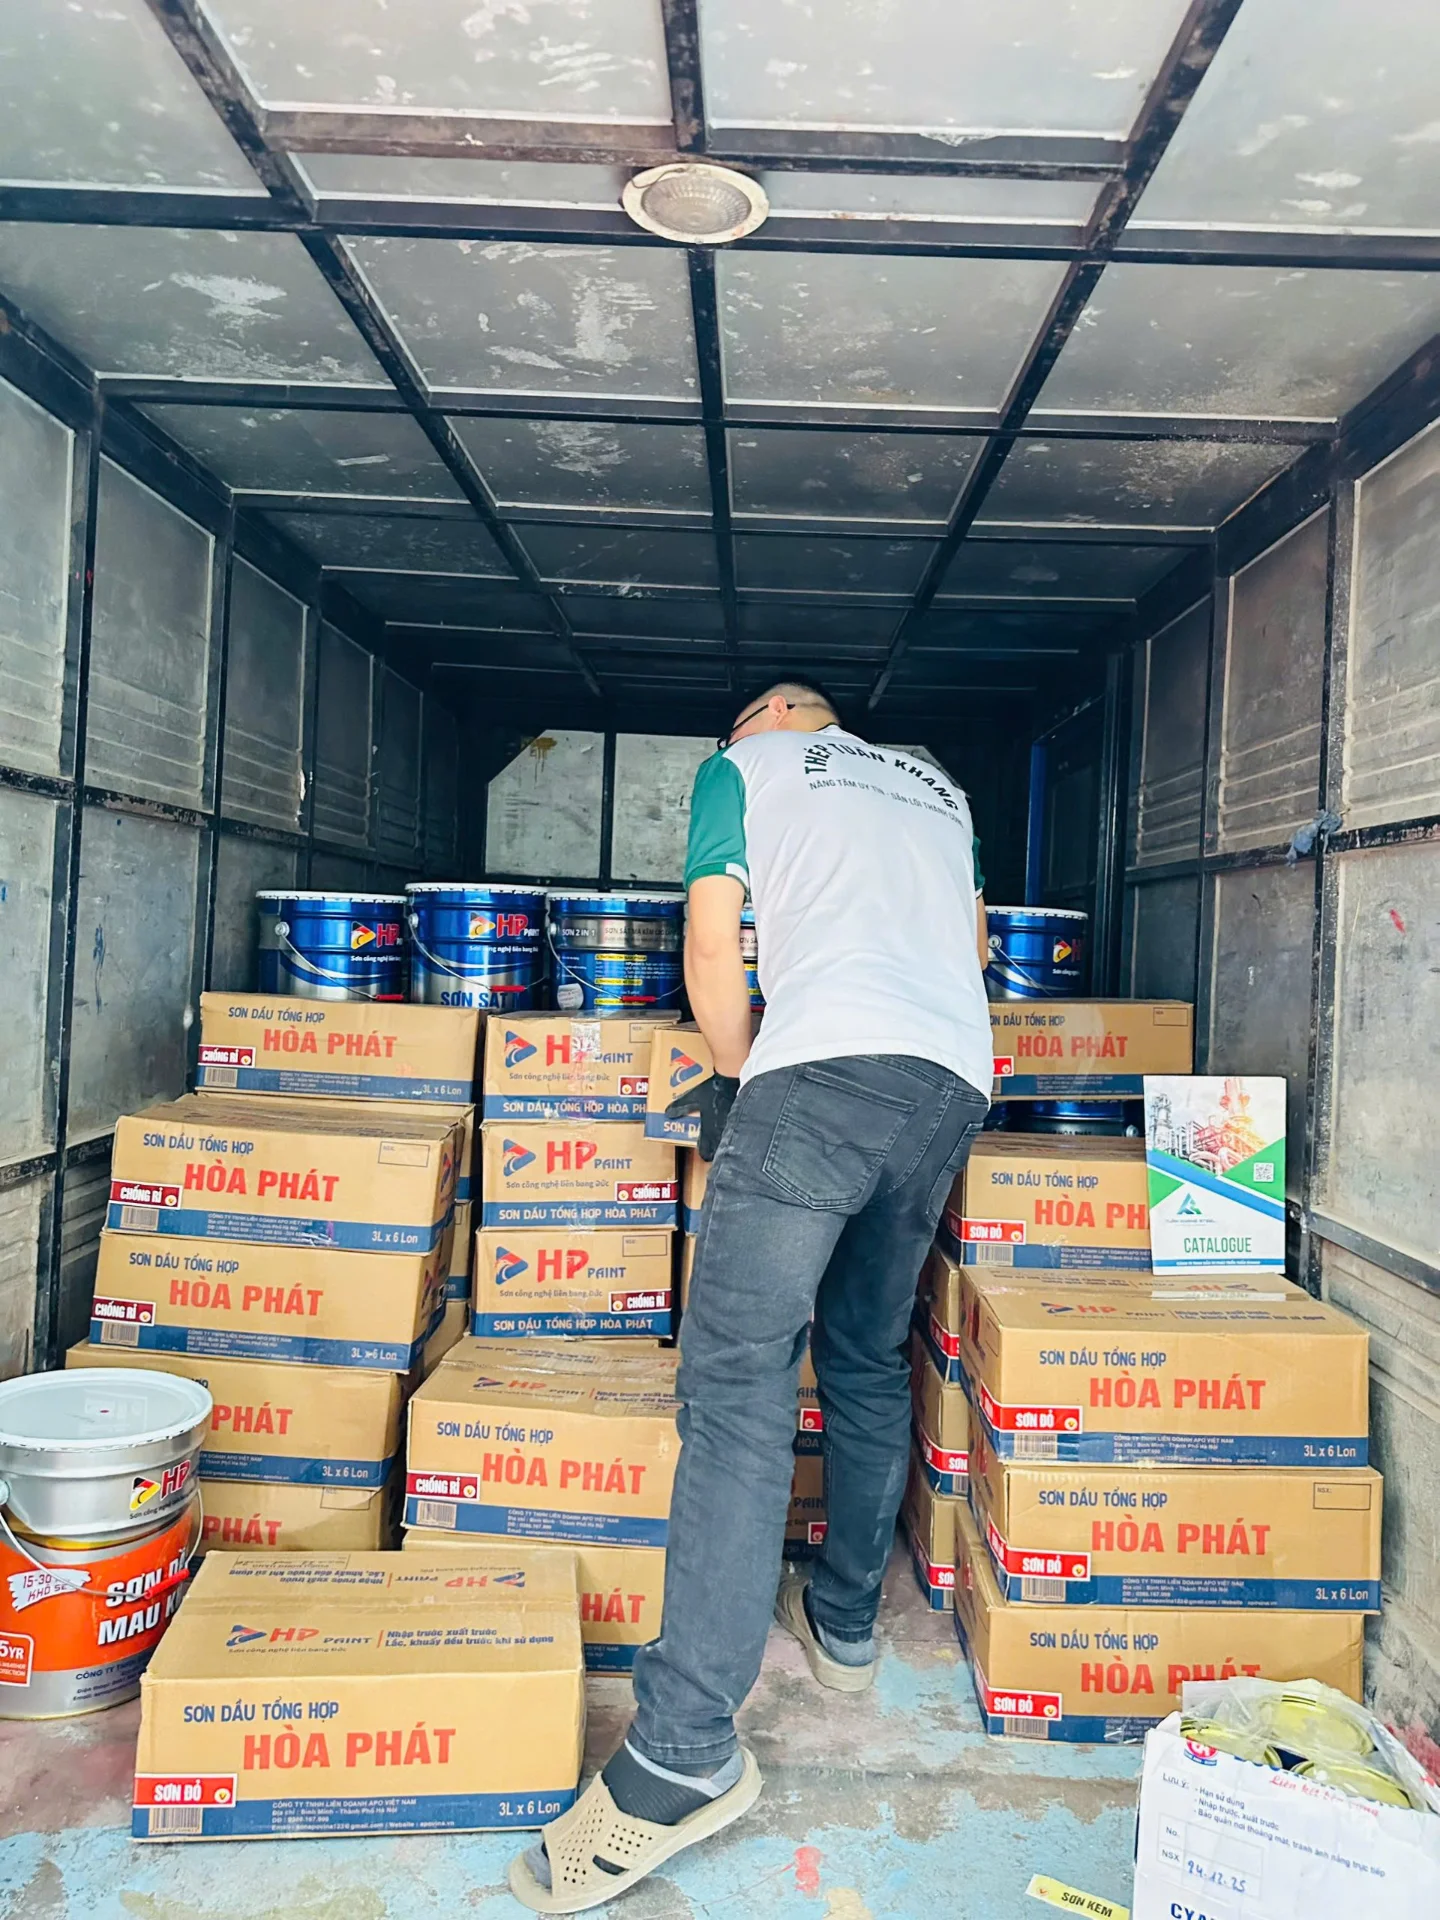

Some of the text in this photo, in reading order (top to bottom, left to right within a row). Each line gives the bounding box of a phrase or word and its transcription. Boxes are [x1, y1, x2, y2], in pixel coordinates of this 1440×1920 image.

[894, 759, 959, 810] KHANG
[497, 913, 529, 938] HP
[440, 990, 473, 1007] SƠN
[228, 1006, 248, 1018] SƠN
[263, 1024, 398, 1058] HÒA PHÁT
[1017, 1030, 1128, 1058] HÒA PHÁT
[143, 1132, 164, 1147] SƠN
[231, 1139, 254, 1156] HỢP
[546, 1140, 633, 1174] HP PAINT
[183, 1159, 340, 1202] HÒA PHÁT
[522, 1181, 539, 1190] công
[992, 1171, 1013, 1185] SƠN
[1077, 1176, 1099, 1191] HỢP
[120, 1184, 151, 1203] CHỐNG
[499, 1206, 520, 1220] SƠN
[605, 1205, 627, 1219] HÒA
[630, 1205, 657, 1218] PHÁT
[1034, 1194, 1149, 1230] HÒA PH
[969, 1226, 988, 1240] SƠN
[1183, 1237, 1252, 1253] CATALOGUE
[537, 1249, 627, 1283] HP PAINT
[169, 1276, 323, 1316] HÒA PHÁT
[94, 1300, 126, 1319] CHỐNG
[1076, 1304, 1117, 1314] HP
[1039, 1349, 1065, 1365] SƠN
[1141, 1351, 1167, 1370] HỢP
[1089, 1370, 1266, 1410] HÒA PHÁT
[210, 1401, 293, 1435] PHÁT
[1015, 1413, 1038, 1428] SƠN
[437, 1421, 460, 1437] SƠN
[530, 1429, 554, 1447] HỢP
[160, 1460, 191, 1501] HP
[483, 1448, 646, 1495] HÒA PHÁT
[415, 1475, 448, 1494] CHỐNG
[1039, 1489, 1066, 1505] SƠN
[1141, 1491, 1168, 1511] HỢP
[201, 1513, 282, 1546] PHÁT
[1091, 1513, 1271, 1555] HÒA PHÁT
[1022, 1557, 1046, 1573] SƠN
[23, 1574, 52, 1588] 15-30
[28, 1585, 51, 1601] KHÔ
[105, 1568, 162, 1608] SƠN
[582, 1587, 646, 1624] HÁT
[97, 1602, 160, 1646] MAU
[269, 1627, 320, 1643] HP
[387, 1630, 414, 1638] Nhập
[446, 1627, 468, 1636] xuất
[410, 1638, 440, 1647] khuấy
[528, 1635, 554, 1644] dụng
[1029, 1631, 1057, 1648] SƠN
[1133, 1633, 1159, 1654] HỢP
[1080, 1654, 1155, 1695] HÒA
[184, 1704, 215, 1723] SƠN
[262, 1695, 303, 1720] TỔNG
[308, 1700, 340, 1723] HỢP
[993, 1697, 1017, 1712] SƠN
[243, 1721, 457, 1770] HÒA PHÁT
[154, 1777, 202, 1802] SƠN ĐỎ
[499, 1801, 560, 1816] 3L x 6 Lon
[1061, 1892, 1113, 1918] SƠN KEM
